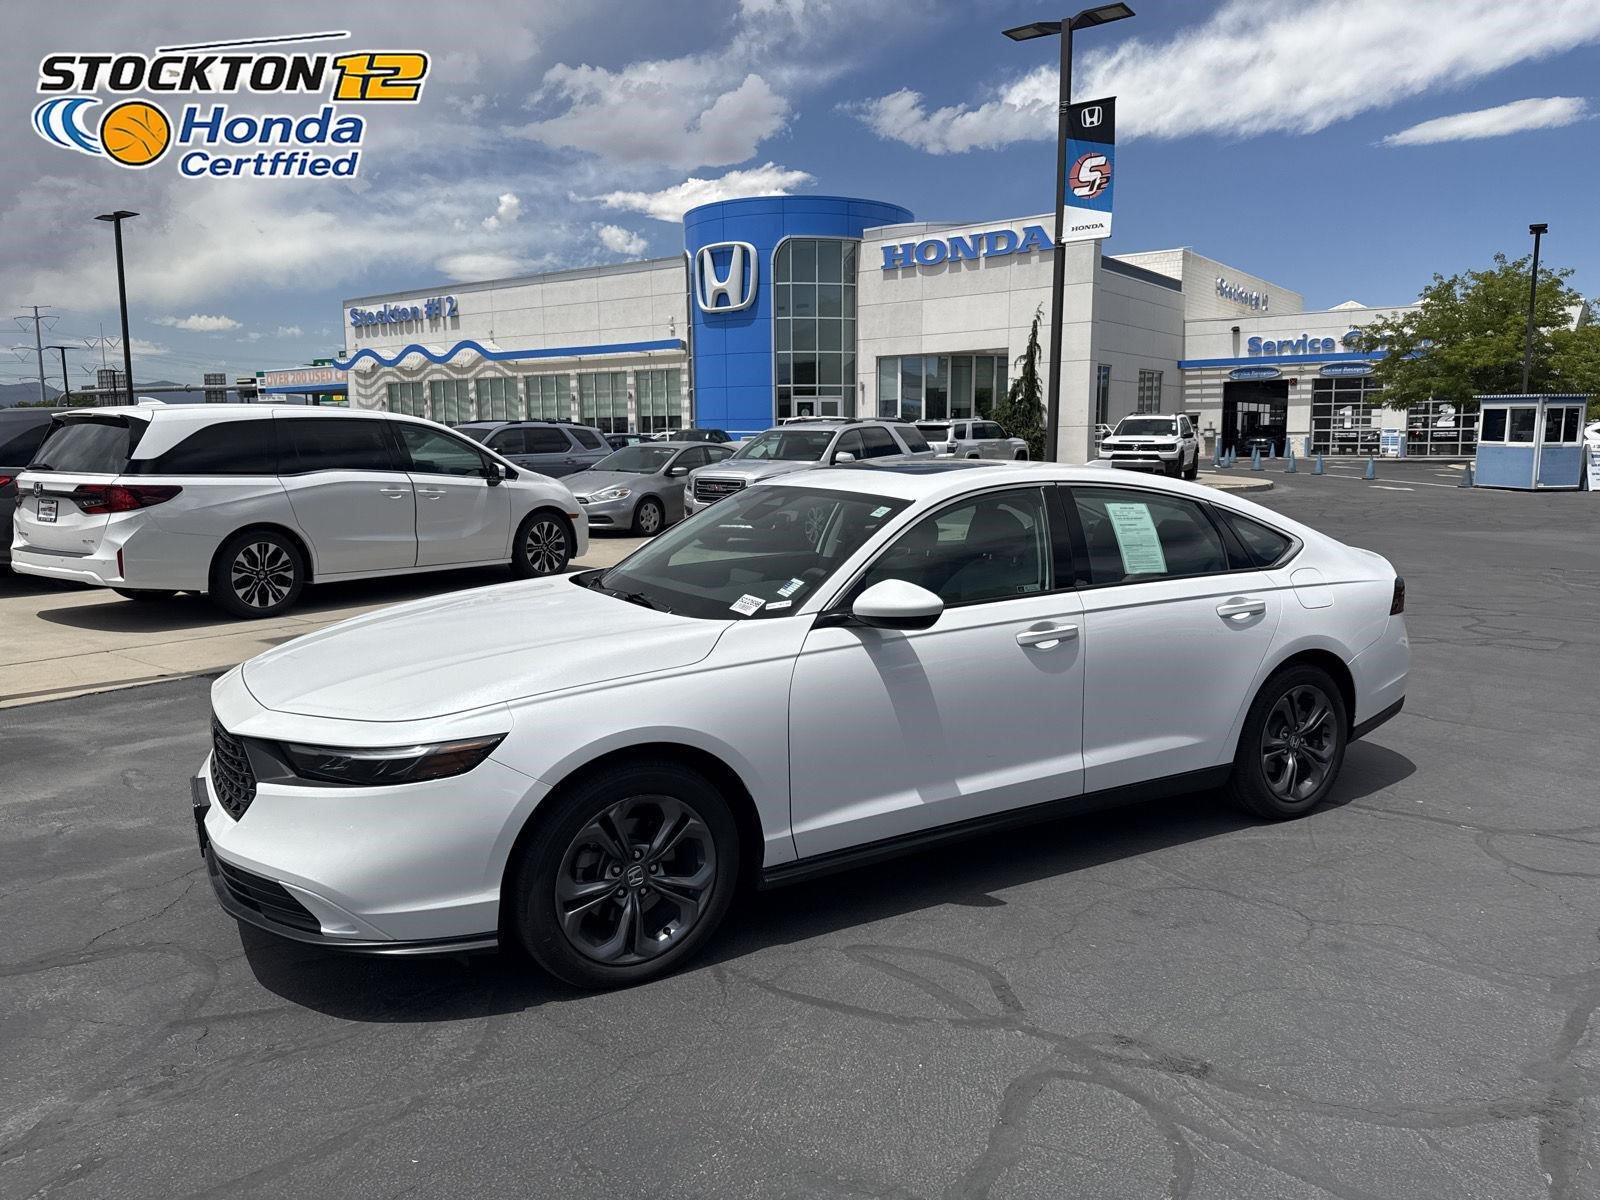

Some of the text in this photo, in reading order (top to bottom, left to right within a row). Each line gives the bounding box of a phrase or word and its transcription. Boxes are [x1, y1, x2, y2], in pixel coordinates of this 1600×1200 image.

[1071, 222, 1104, 232] HONDA
[881, 224, 1055, 271] HONDA
[349, 303, 420, 328] Stockton
[1247, 333, 1336, 354] Service
[267, 372, 289, 386] OVER
[1339, 405, 1352, 429] 1
[1436, 403, 1455, 428] 2
